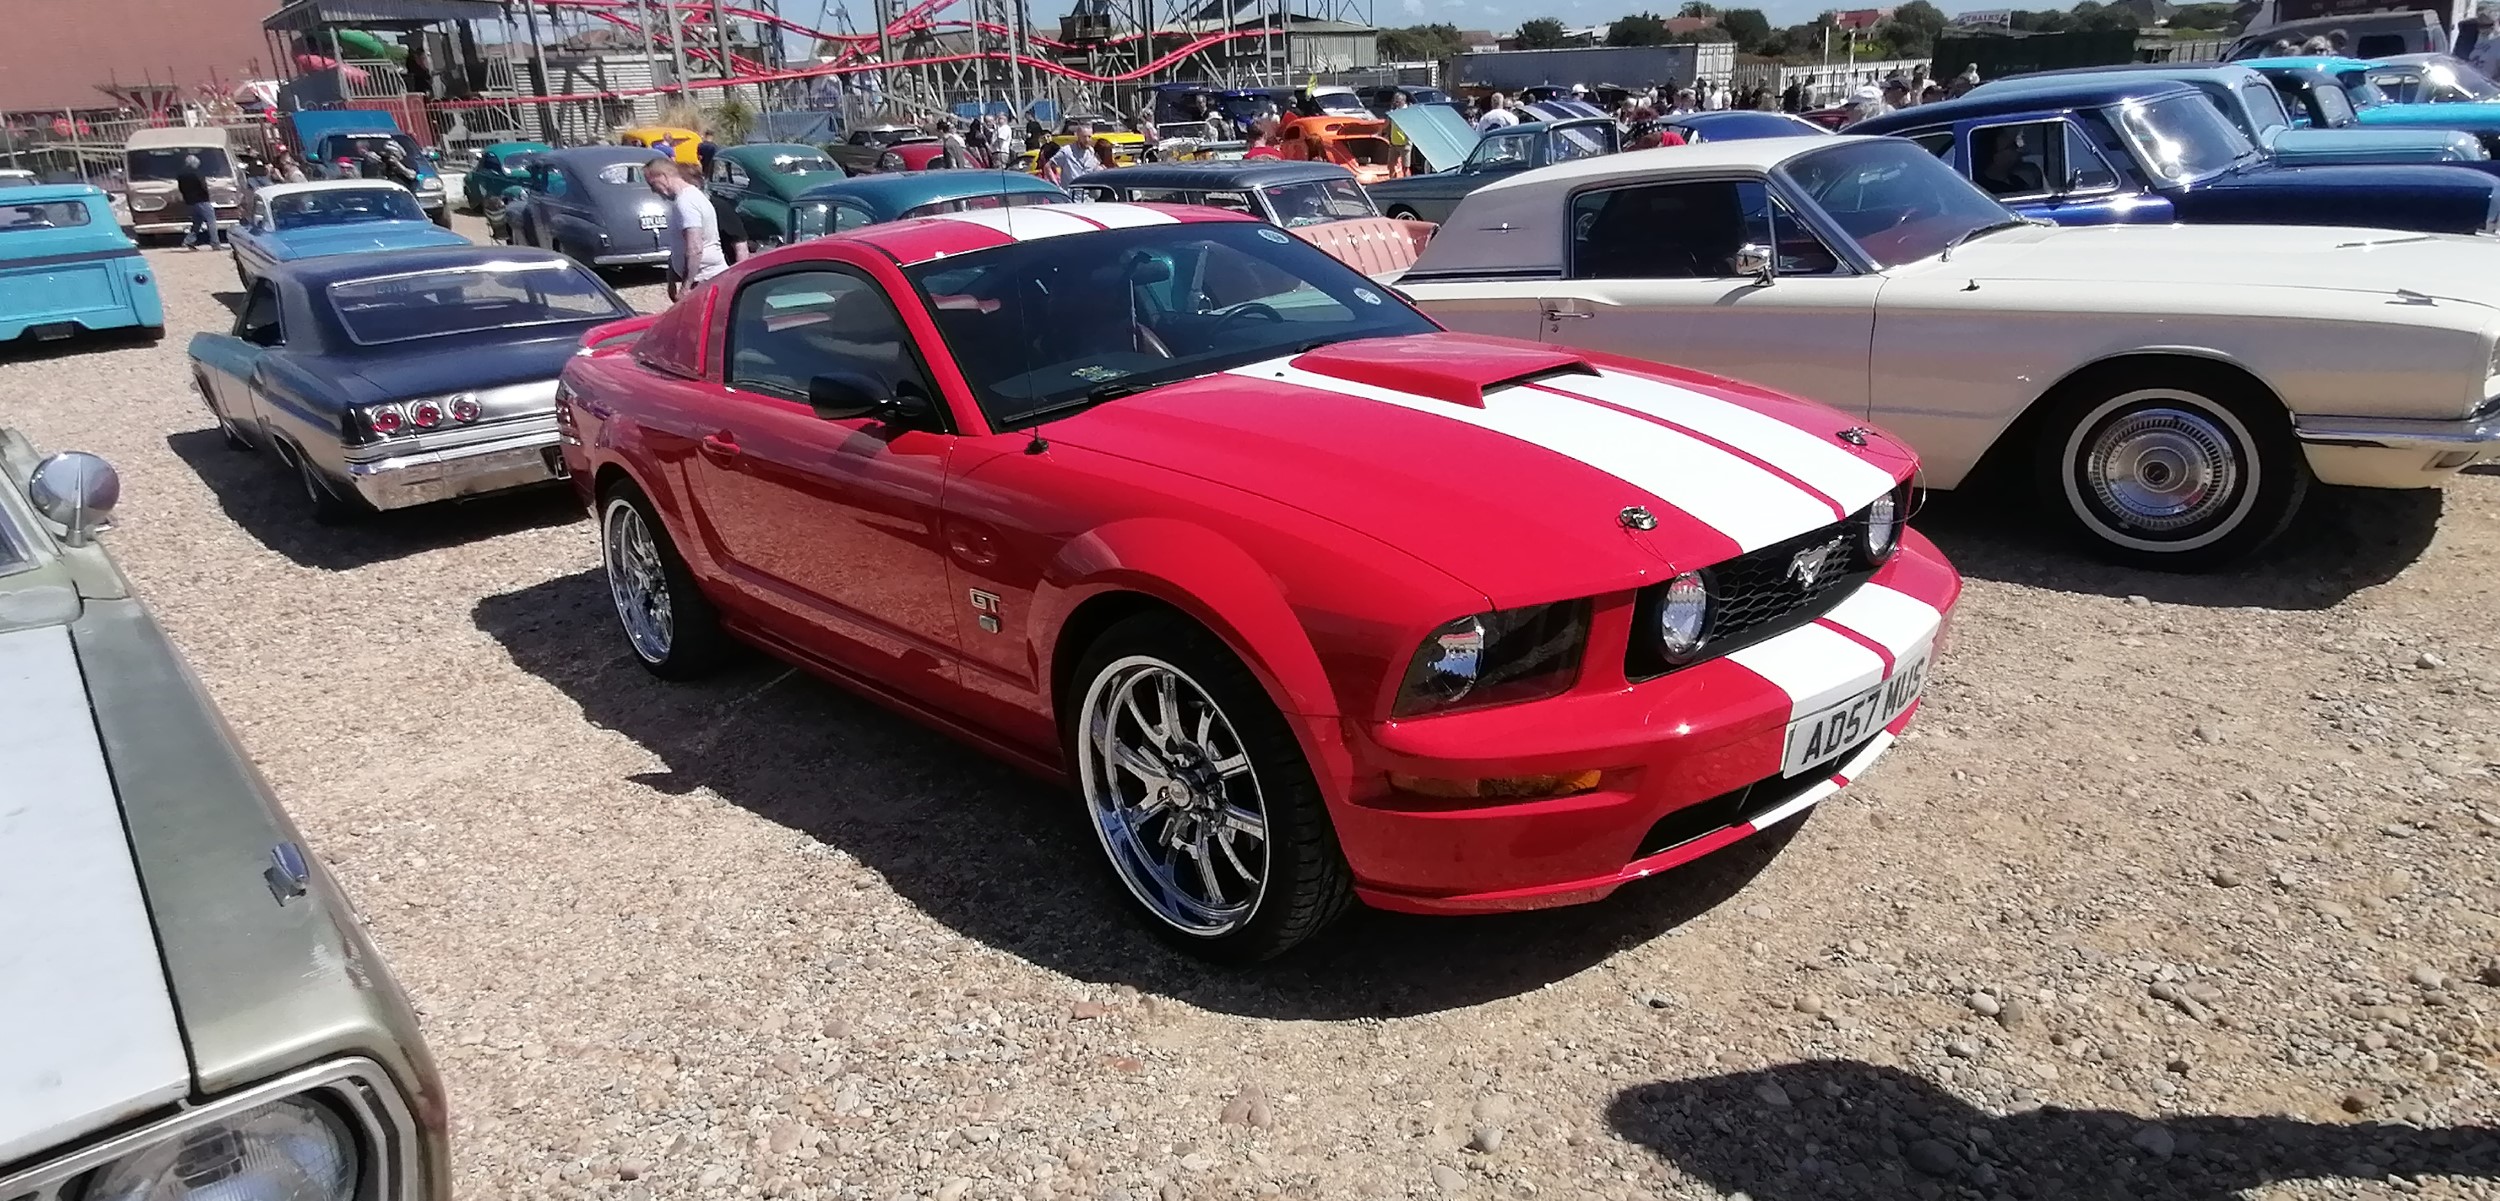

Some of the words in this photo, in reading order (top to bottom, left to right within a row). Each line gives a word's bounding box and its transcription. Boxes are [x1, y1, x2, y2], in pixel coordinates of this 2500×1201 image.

[970, 588, 1000, 613] GT
[1801, 688, 1882, 765] AD57
[1882, 657, 1925, 721] MUS
